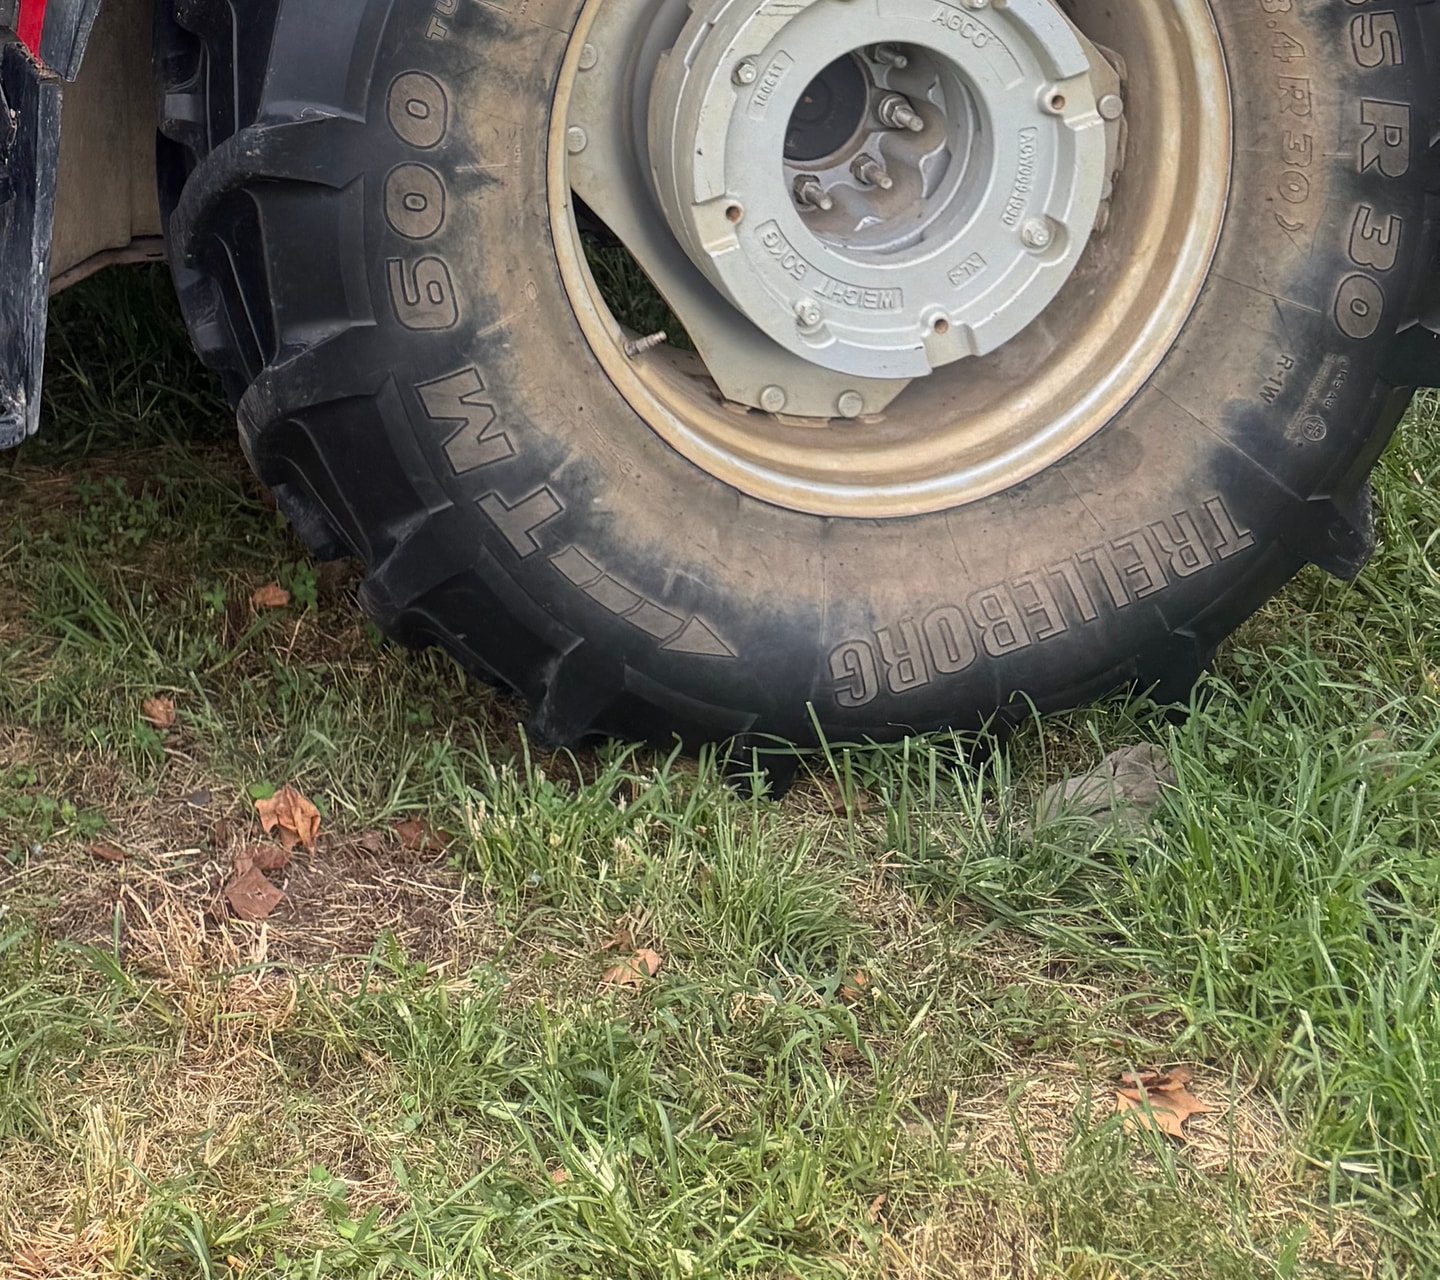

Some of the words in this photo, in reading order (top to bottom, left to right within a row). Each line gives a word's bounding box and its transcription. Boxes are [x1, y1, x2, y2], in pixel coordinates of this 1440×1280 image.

[931, 7, 991, 49] AGCO
[1273, 77, 1312, 116] R
[1360, 99, 1410, 180] R
[384, 69, 459, 331] 600
[762, 230, 808, 282] 50KG
[1334, 205, 1403, 340] 30
[813, 276, 894, 310] WEIGHT
[828, 496, 1256, 708] TRELLEBORG
